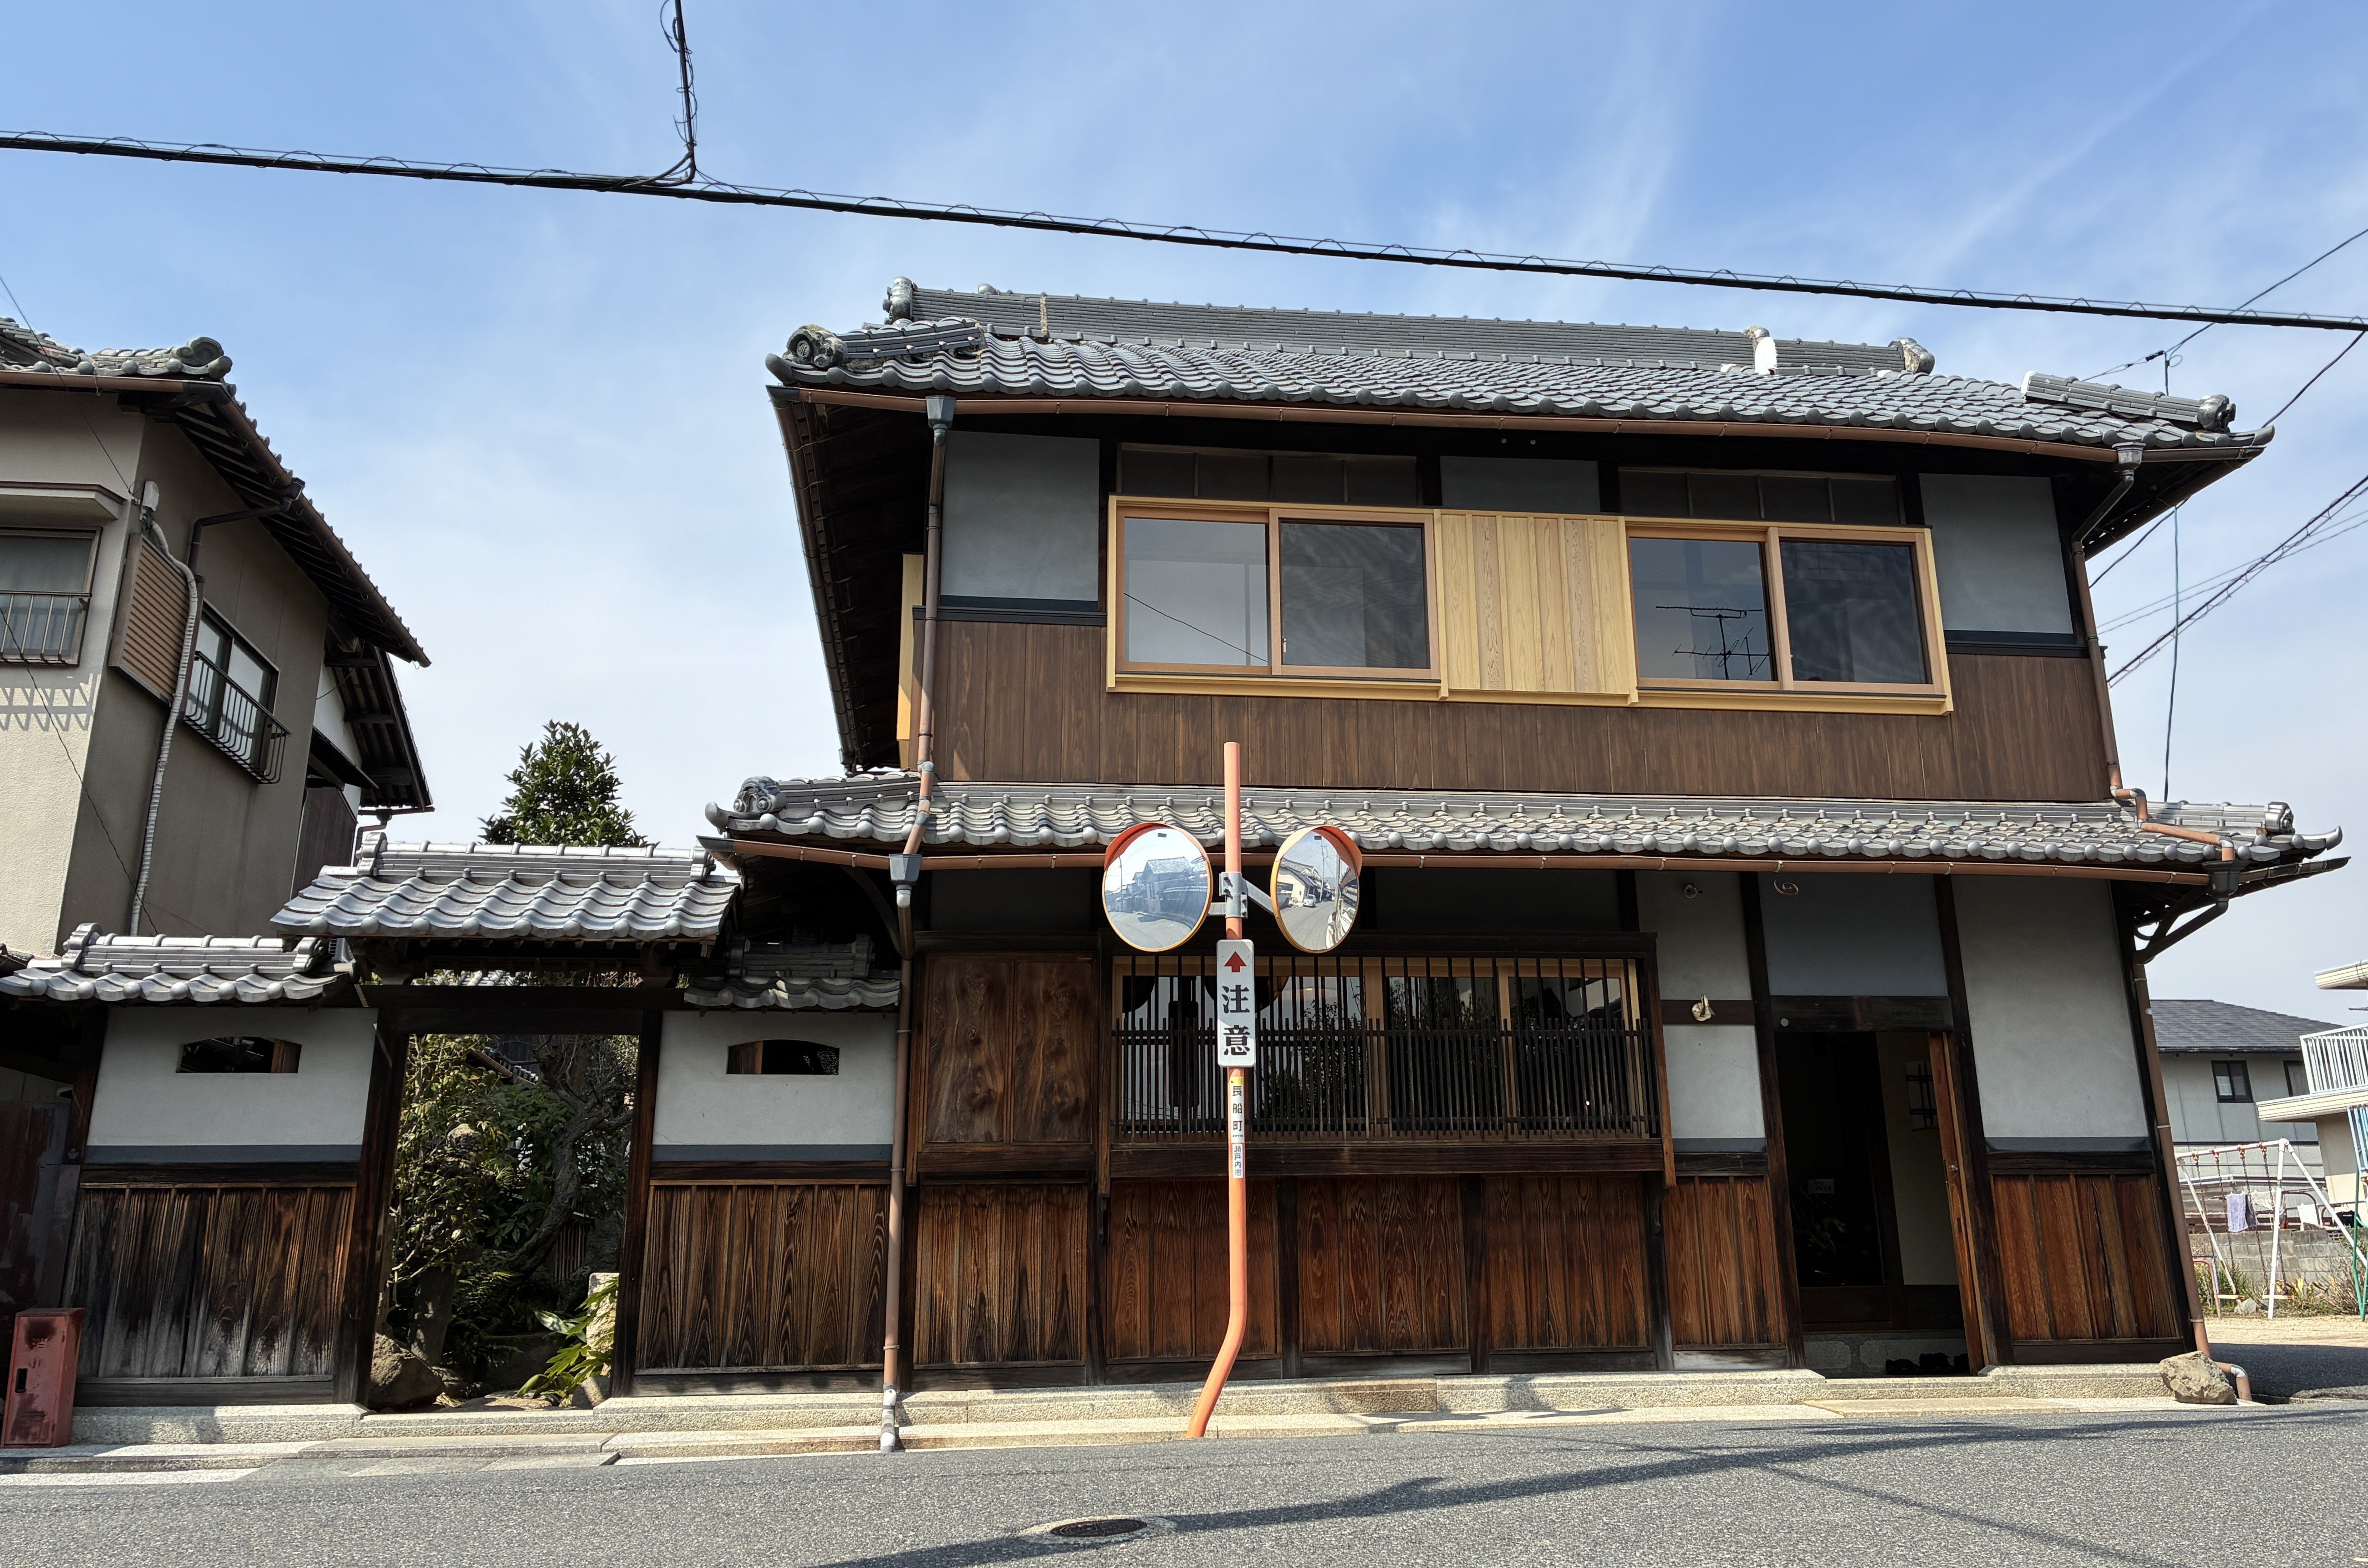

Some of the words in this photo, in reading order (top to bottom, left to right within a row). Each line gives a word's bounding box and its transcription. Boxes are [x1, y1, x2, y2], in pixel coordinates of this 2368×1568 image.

[1222, 984, 1250, 1056] 注意
[1232, 1085, 1243, 1131] 長船町
